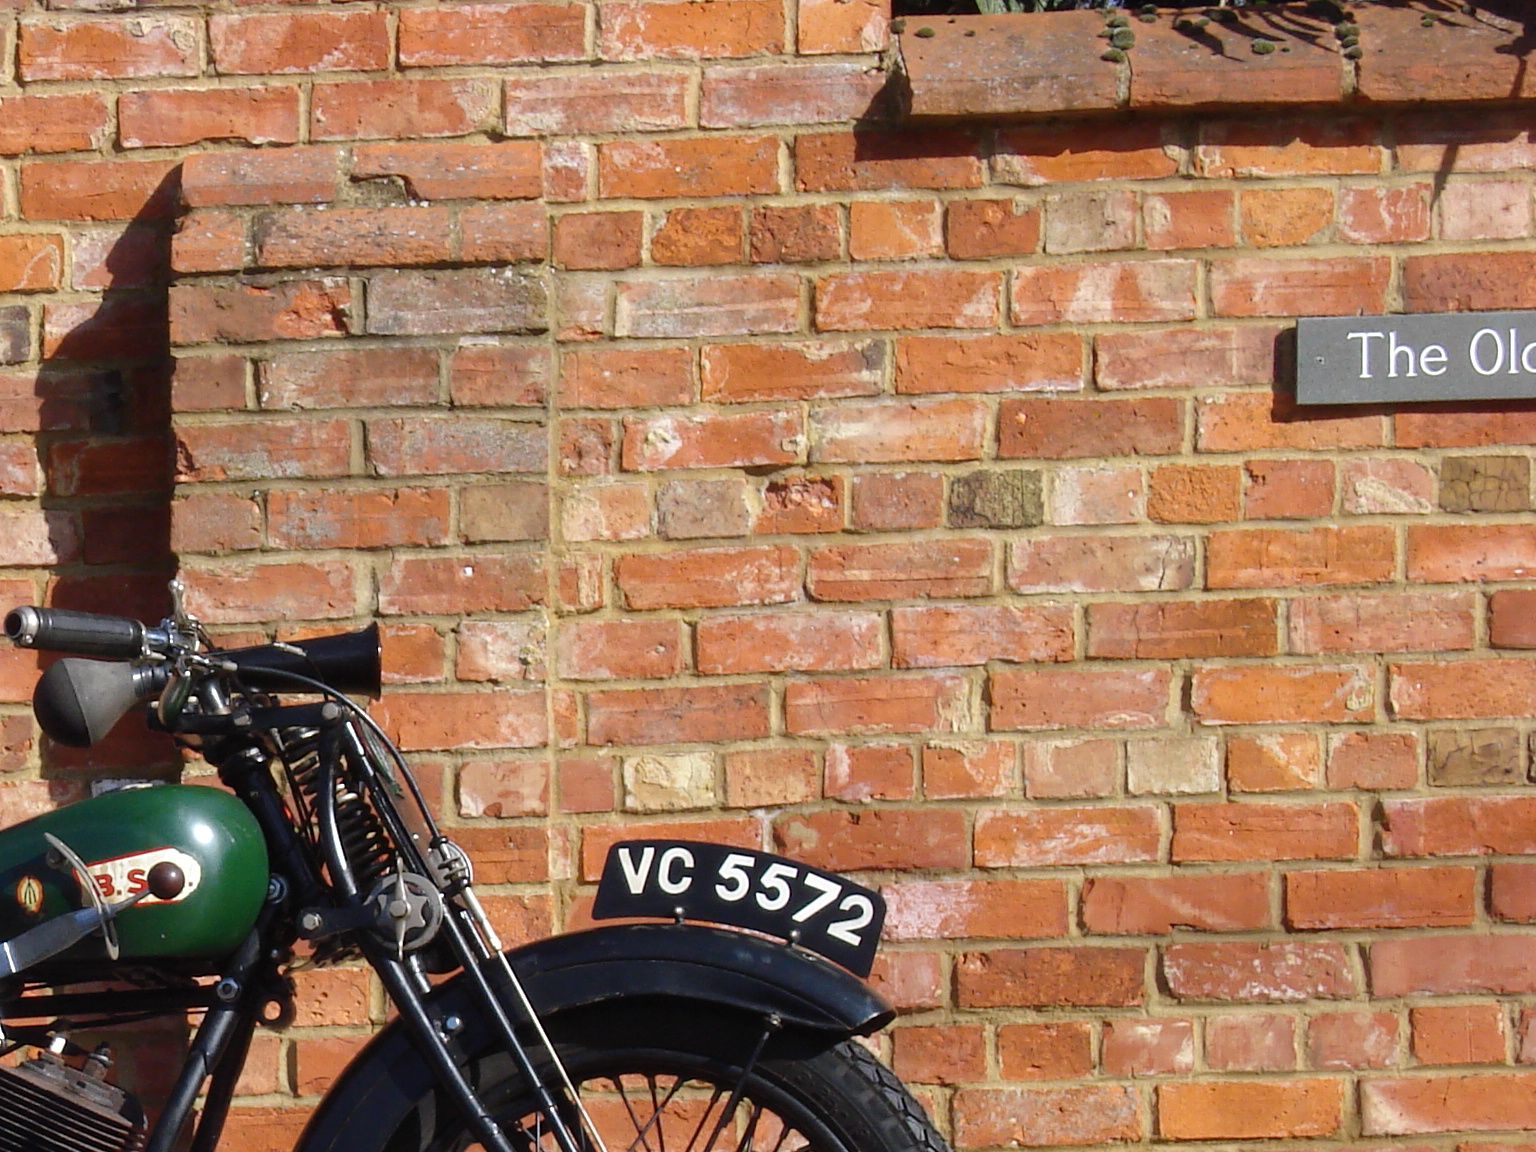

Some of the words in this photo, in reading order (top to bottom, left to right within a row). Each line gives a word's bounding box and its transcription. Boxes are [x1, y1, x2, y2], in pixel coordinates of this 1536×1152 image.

[1347, 329, 1449, 379] The
[617, 846, 696, 895] VC
[714, 853, 875, 947] 5572
